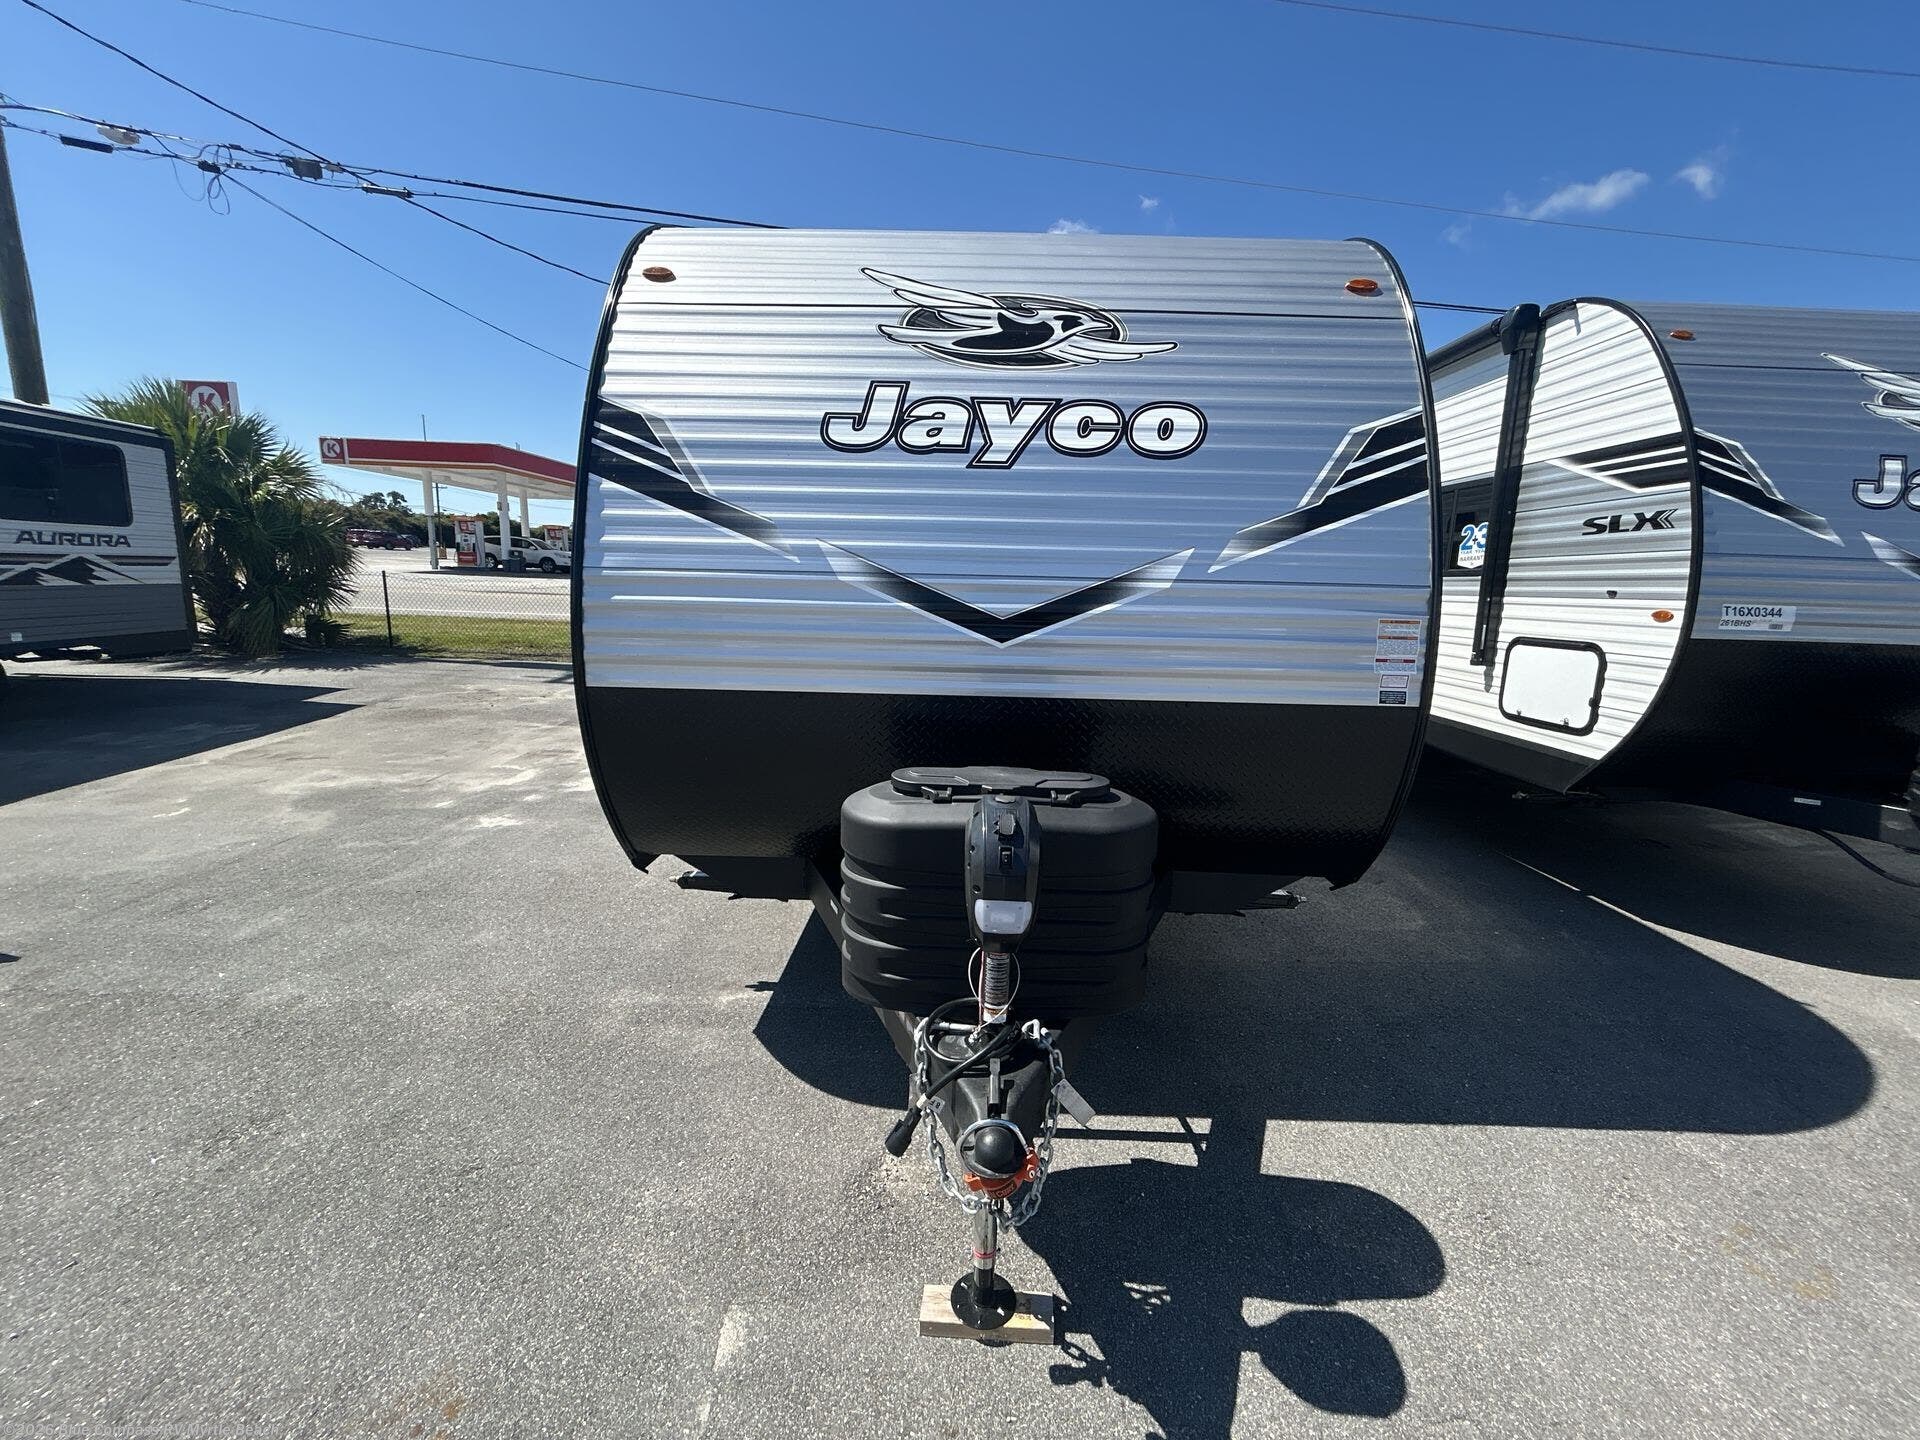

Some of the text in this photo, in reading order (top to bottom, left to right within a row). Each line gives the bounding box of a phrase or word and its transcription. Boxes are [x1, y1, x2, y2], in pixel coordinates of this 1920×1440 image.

[820, 380, 1207, 469] Jayco
[327, 443, 337, 454] K
[1582, 508, 1678, 535] SLX
[14, 530, 131, 547] AURORA
[1724, 605, 1782, 618] T16X0344
